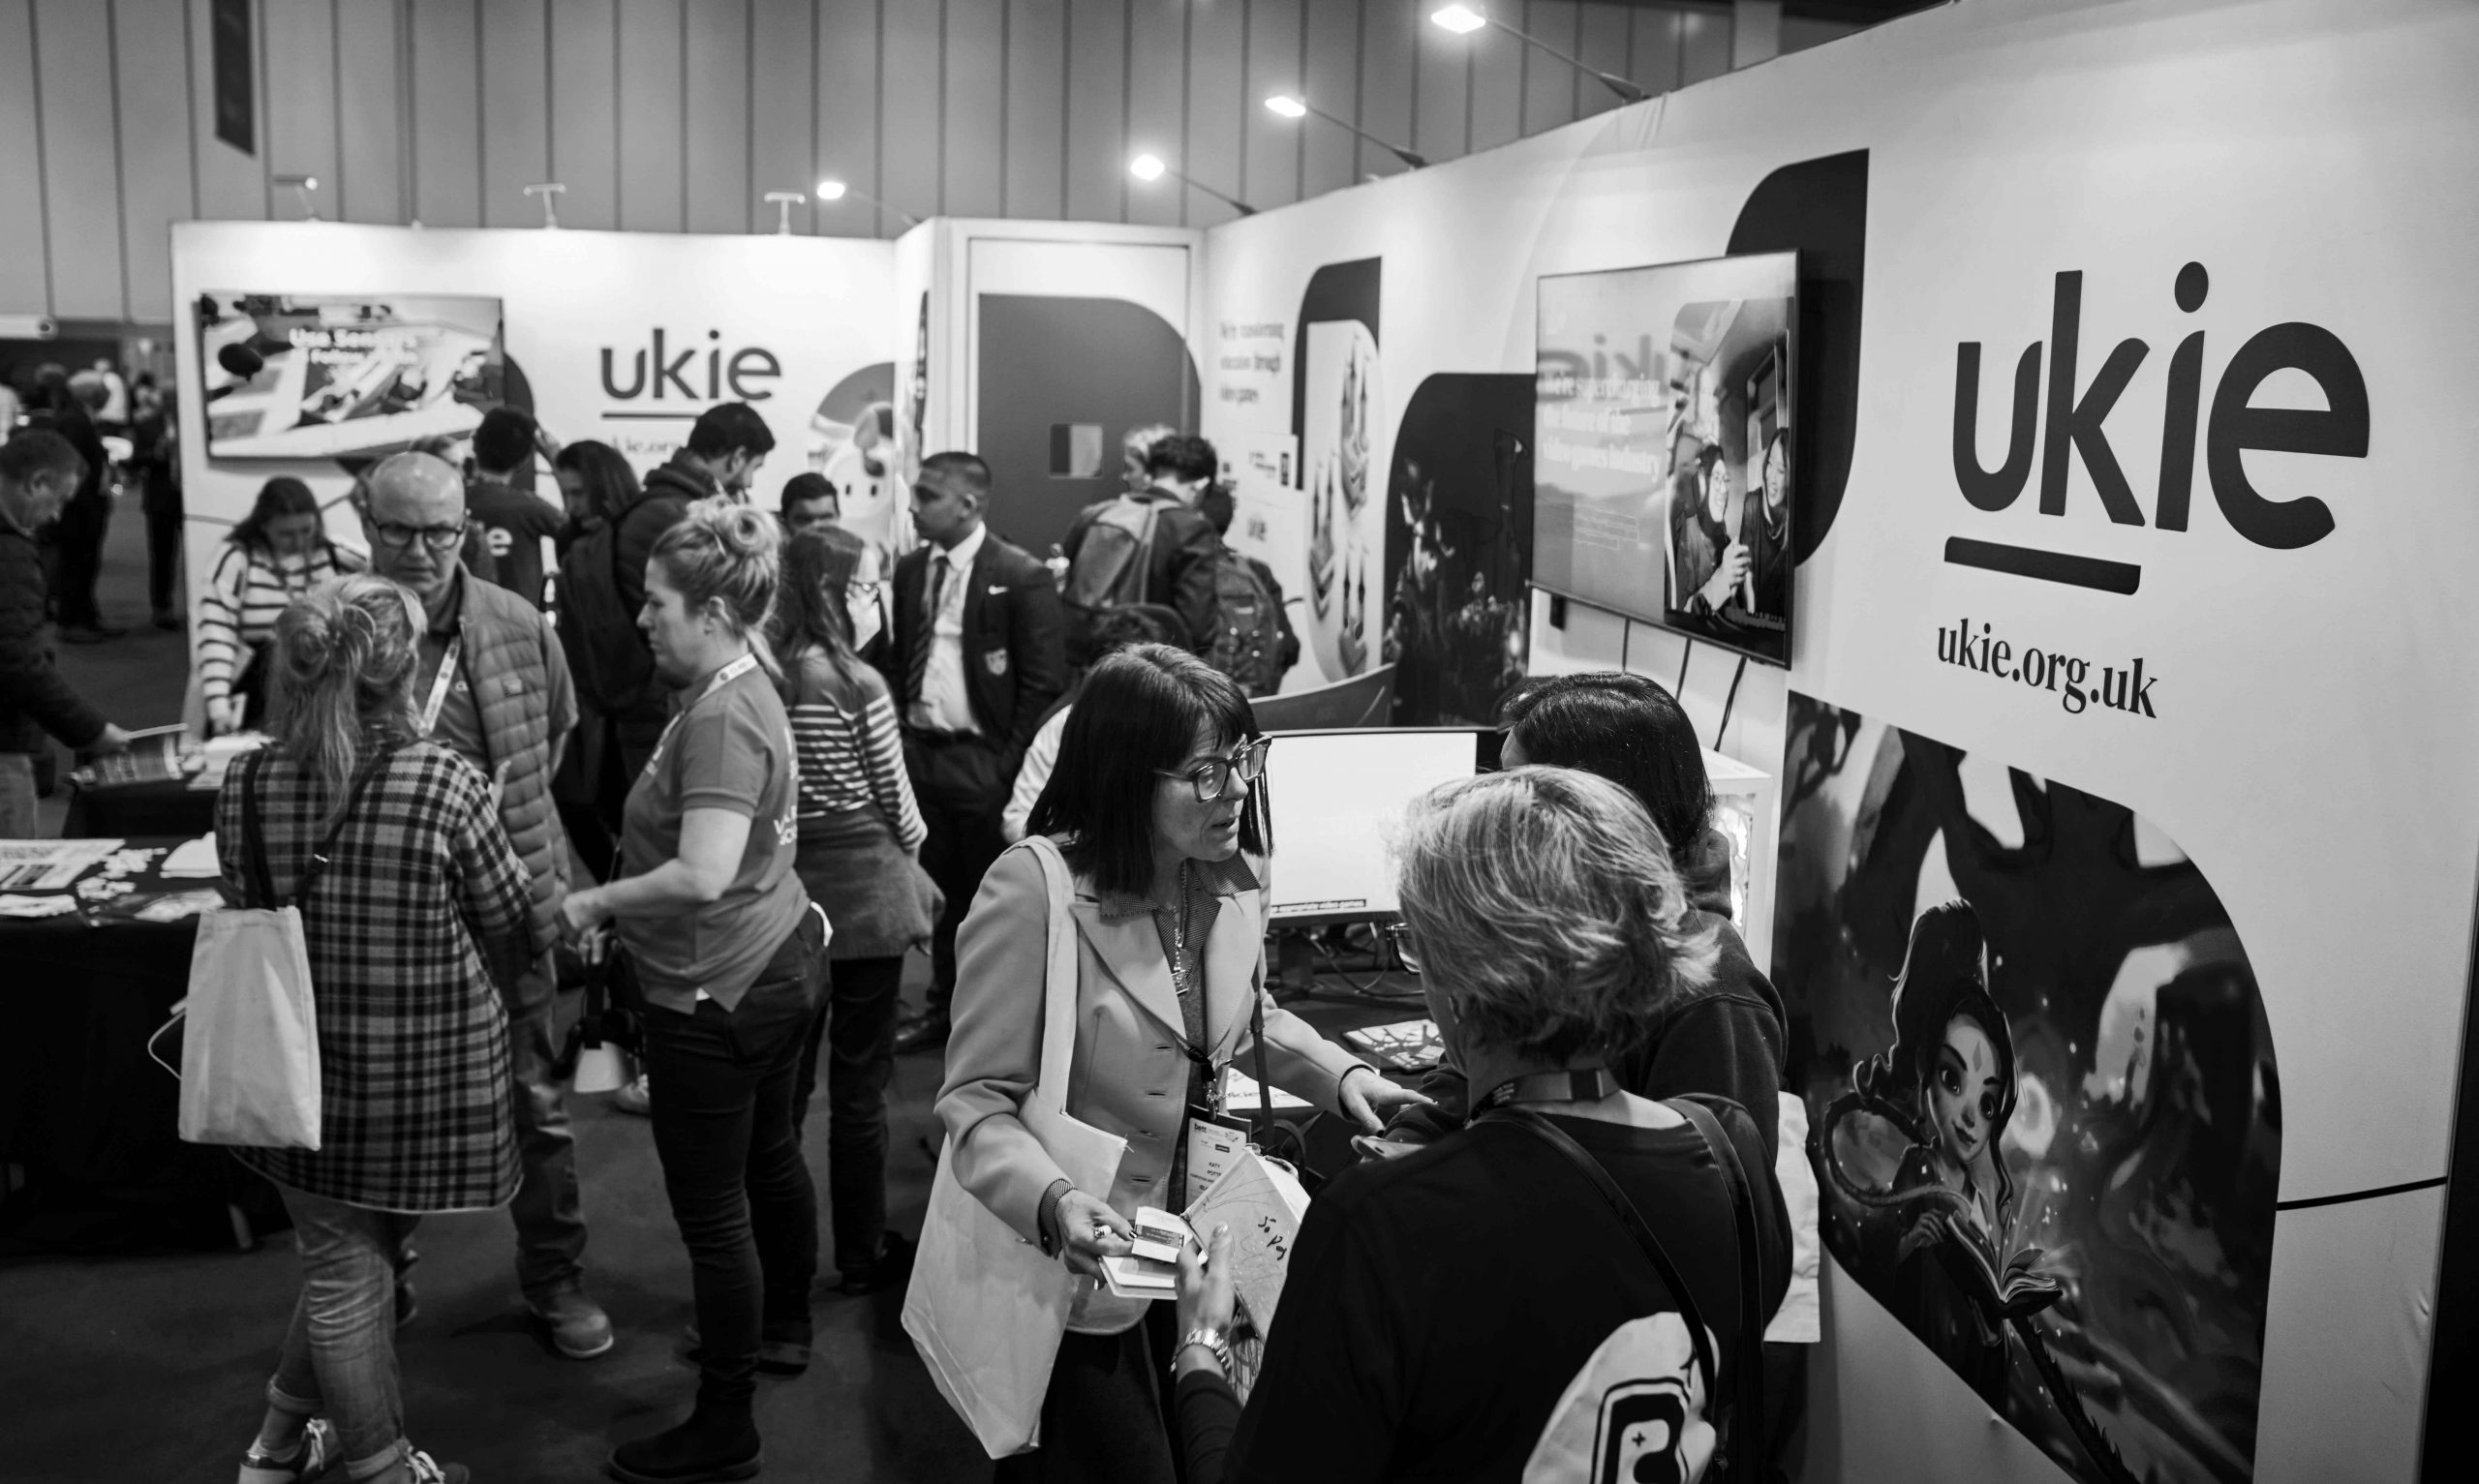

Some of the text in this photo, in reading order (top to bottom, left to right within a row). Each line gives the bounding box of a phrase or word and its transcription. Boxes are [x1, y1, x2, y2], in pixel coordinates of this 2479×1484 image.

[600, 328, 781, 401] ukie
[1952, 261, 2371, 550] ukie
[1938, 618, 2158, 719] ukie.org.uk
